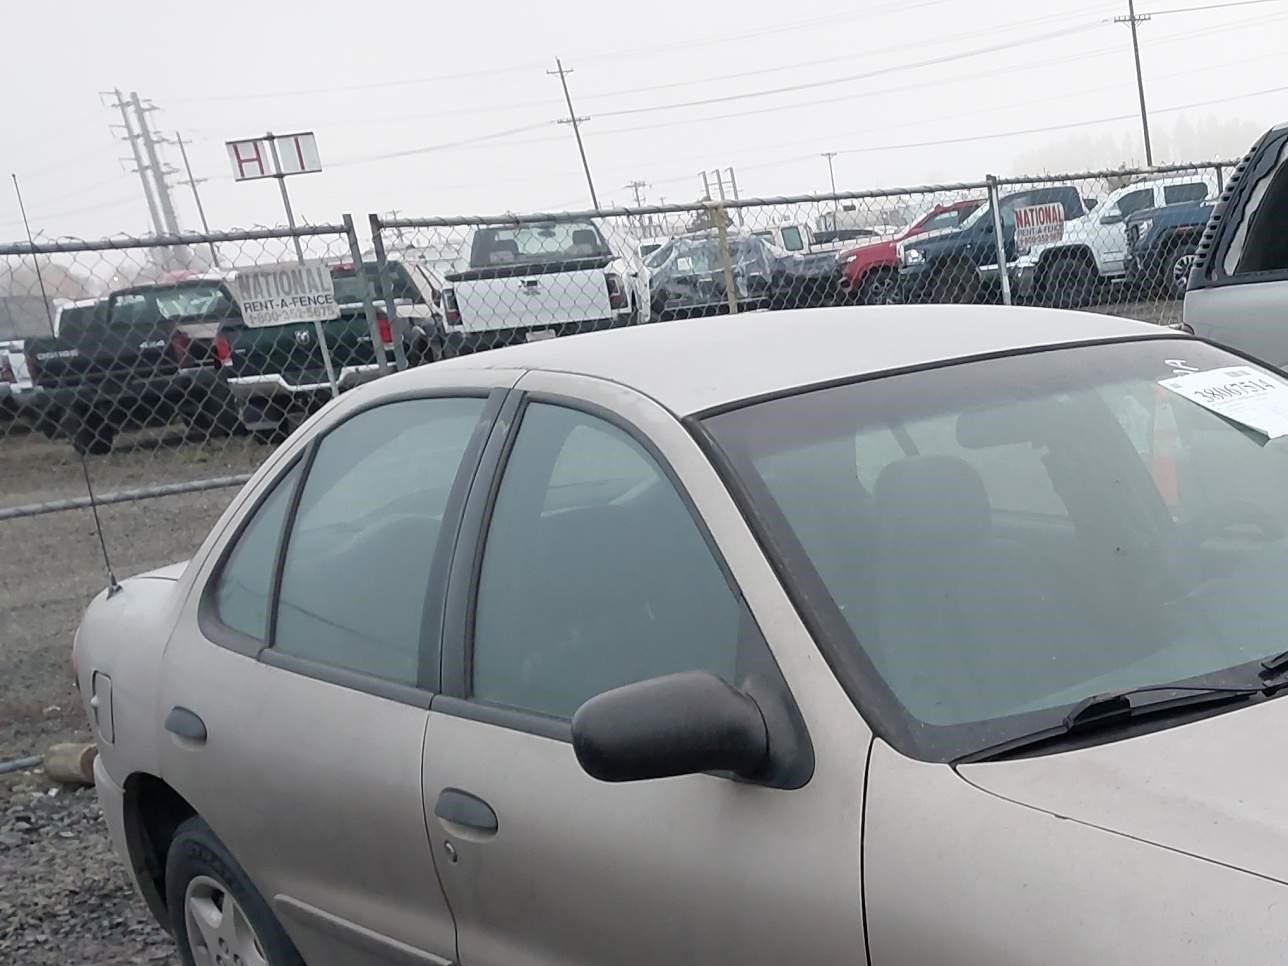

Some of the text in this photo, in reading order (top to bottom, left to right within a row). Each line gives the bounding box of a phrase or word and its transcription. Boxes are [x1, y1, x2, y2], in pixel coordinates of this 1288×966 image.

[1015, 204, 1063, 229] NATIONAL
[236, 266, 332, 301] NATIONAL
[243, 294, 334, 313] RENT-A-FENCE
[1194, 378, 1277, 403] 38067514
